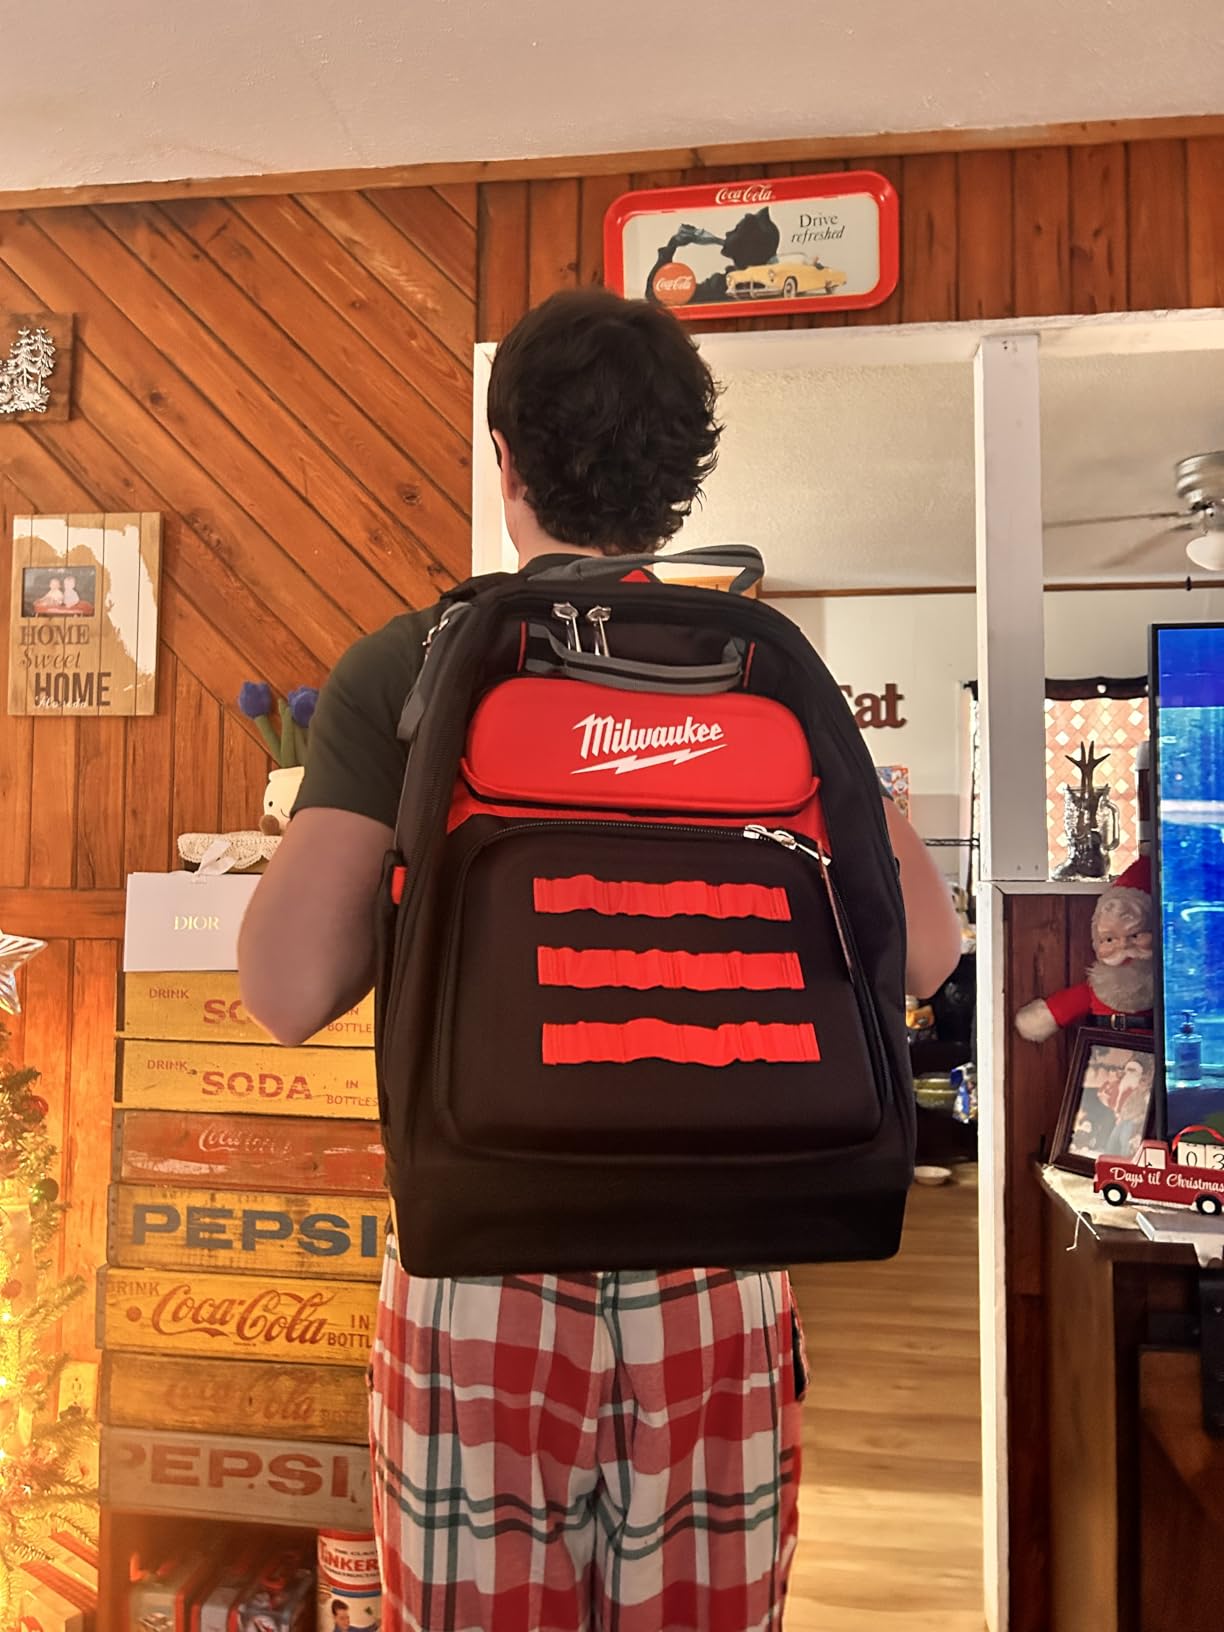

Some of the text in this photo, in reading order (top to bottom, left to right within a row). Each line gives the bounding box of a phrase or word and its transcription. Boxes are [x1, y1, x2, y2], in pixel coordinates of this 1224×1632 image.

[799, 212, 839, 229] Drive
[791, 225, 847, 244] refreshed
[20, 624, 90, 646] HOME
[21, 648, 81, 669] Sweet
[34, 672, 112, 707] HOME
[839, 683, 907, 729] at
[572, 712, 725, 760] Milwaukee
[174, 915, 220, 930] DIOR
[149, 988, 190, 999] DRINK
[327, 1022, 372, 1033] BOTTLE
[147, 1059, 188, 1071] DRINK
[201, 1071, 312, 1100] SODA
[346, 1080, 359, 1089] IN
[131, 1204, 378, 1258] PEPSI
[351, 1314, 370, 1330] IN
[327, 1332, 372, 1348] BOTTL
